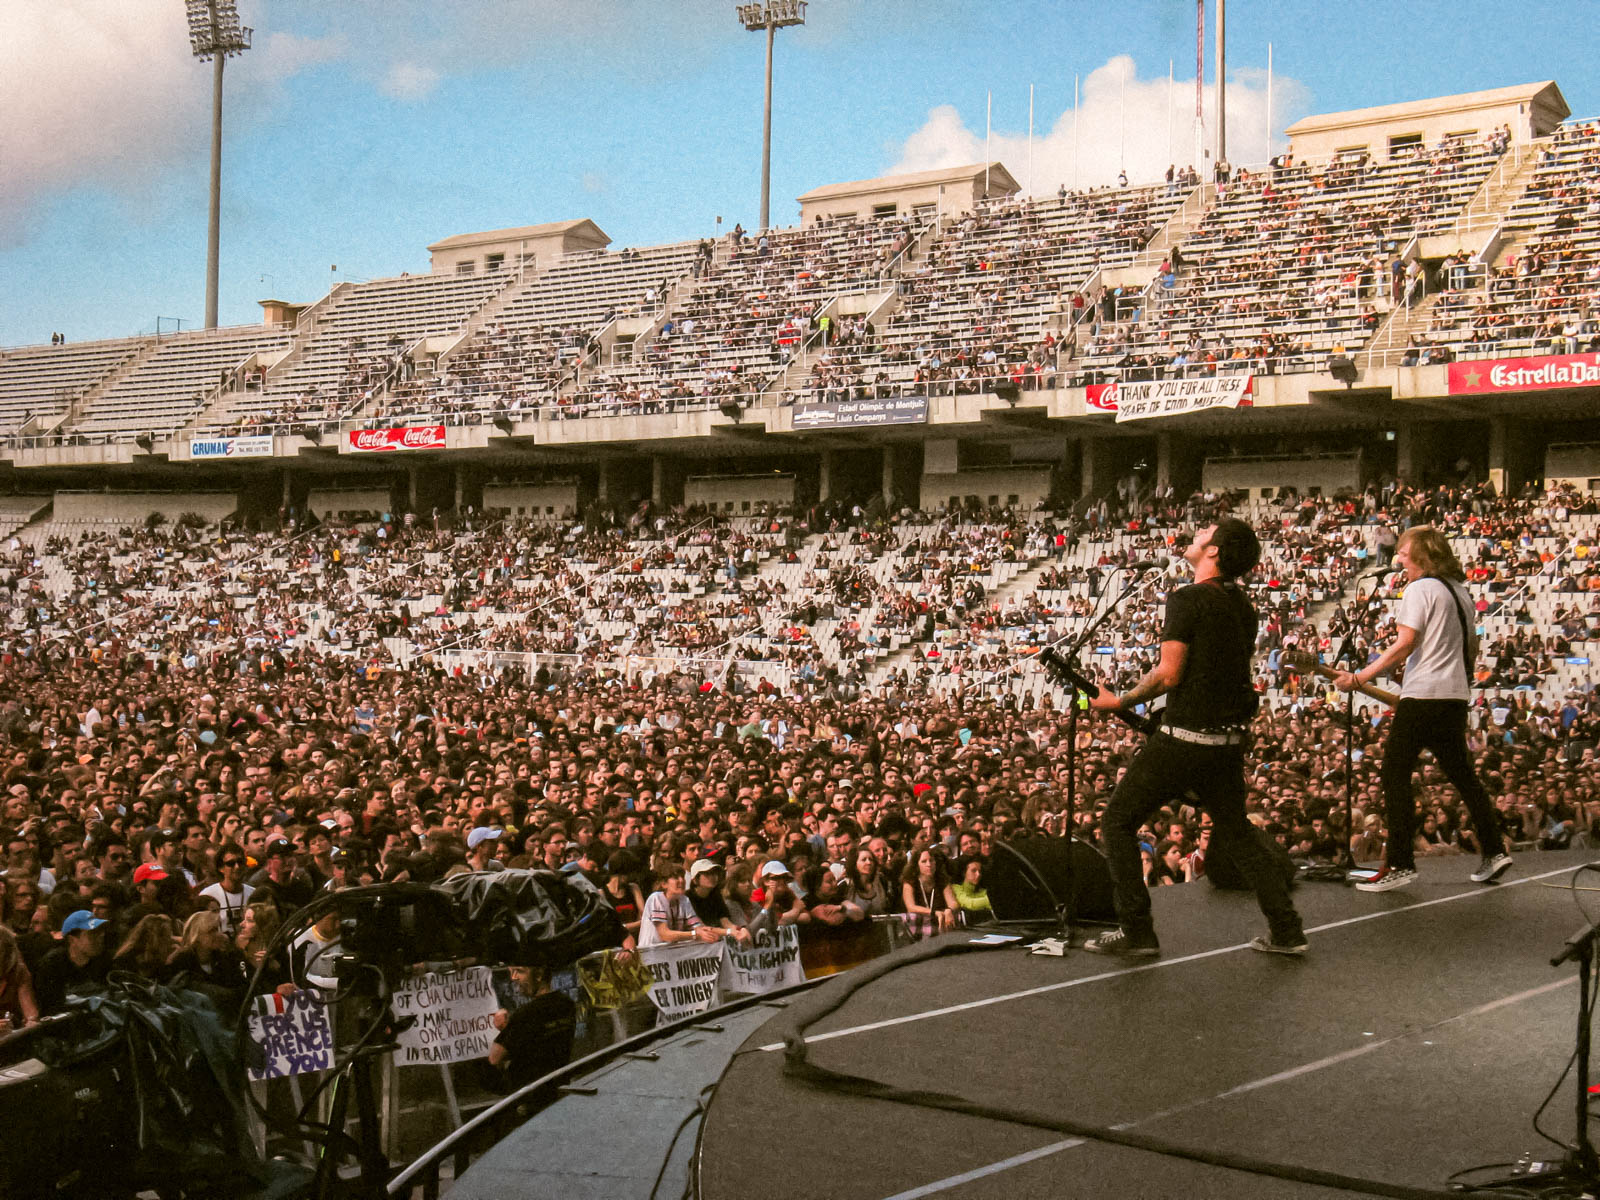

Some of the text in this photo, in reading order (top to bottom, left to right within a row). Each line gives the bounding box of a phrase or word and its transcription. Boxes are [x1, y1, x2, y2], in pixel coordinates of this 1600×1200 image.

[1489, 361, 1600, 387] Estrella Da
[1120, 379, 1242, 401] THANK YOU FOR ALL THESE
[838, 404, 858, 413] Estadi
[885, 401, 895, 410] de
[853, 413, 887, 423] Companys
[1120, 402, 1148, 417] YEARS
[1149, 400, 1161, 414] OF
[416, 990, 442, 1009] CHA
[443, 983, 464, 1002] CHA
[466, 977, 493, 999] CHA
[261, 1008, 327, 1037] FOR US
[423, 1008, 452, 1028] MAKE
[419, 1024, 447, 1045] ONE
[406, 1047, 419, 1061] IN
[454, 1034, 489, 1057] SPAIN
[285, 1049, 329, 1076] YOU
